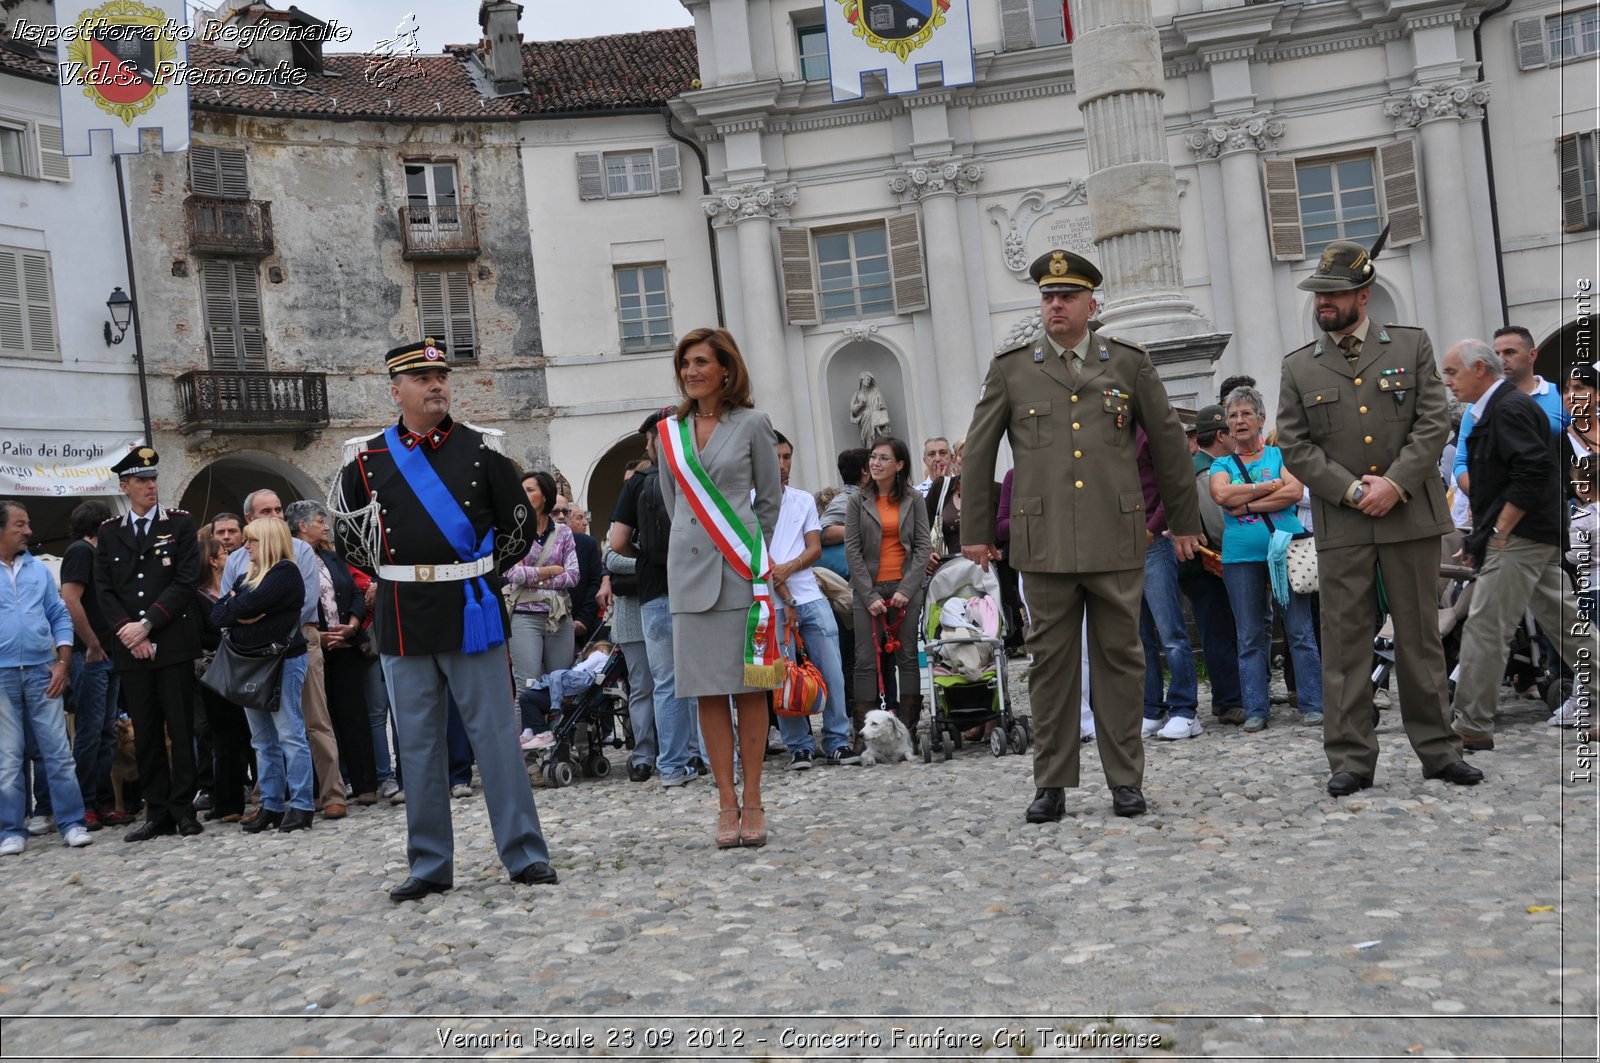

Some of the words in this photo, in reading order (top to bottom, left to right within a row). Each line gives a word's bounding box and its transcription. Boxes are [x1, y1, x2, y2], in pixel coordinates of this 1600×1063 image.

[1051, 223, 1066, 231] DIVO
[2, 441, 33, 457] Palio
[38, 443, 57, 457] dei
[62, 444, 104, 460] Borghi
[0, 464, 33, 481] orgo
[34, 463, 50, 478] S.
[52, 463, 112, 481] Giusepp
[15, 482, 51, 492] Domenica
[53, 485, 67, 495] 30
[69, 484, 107, 492] Settembre
